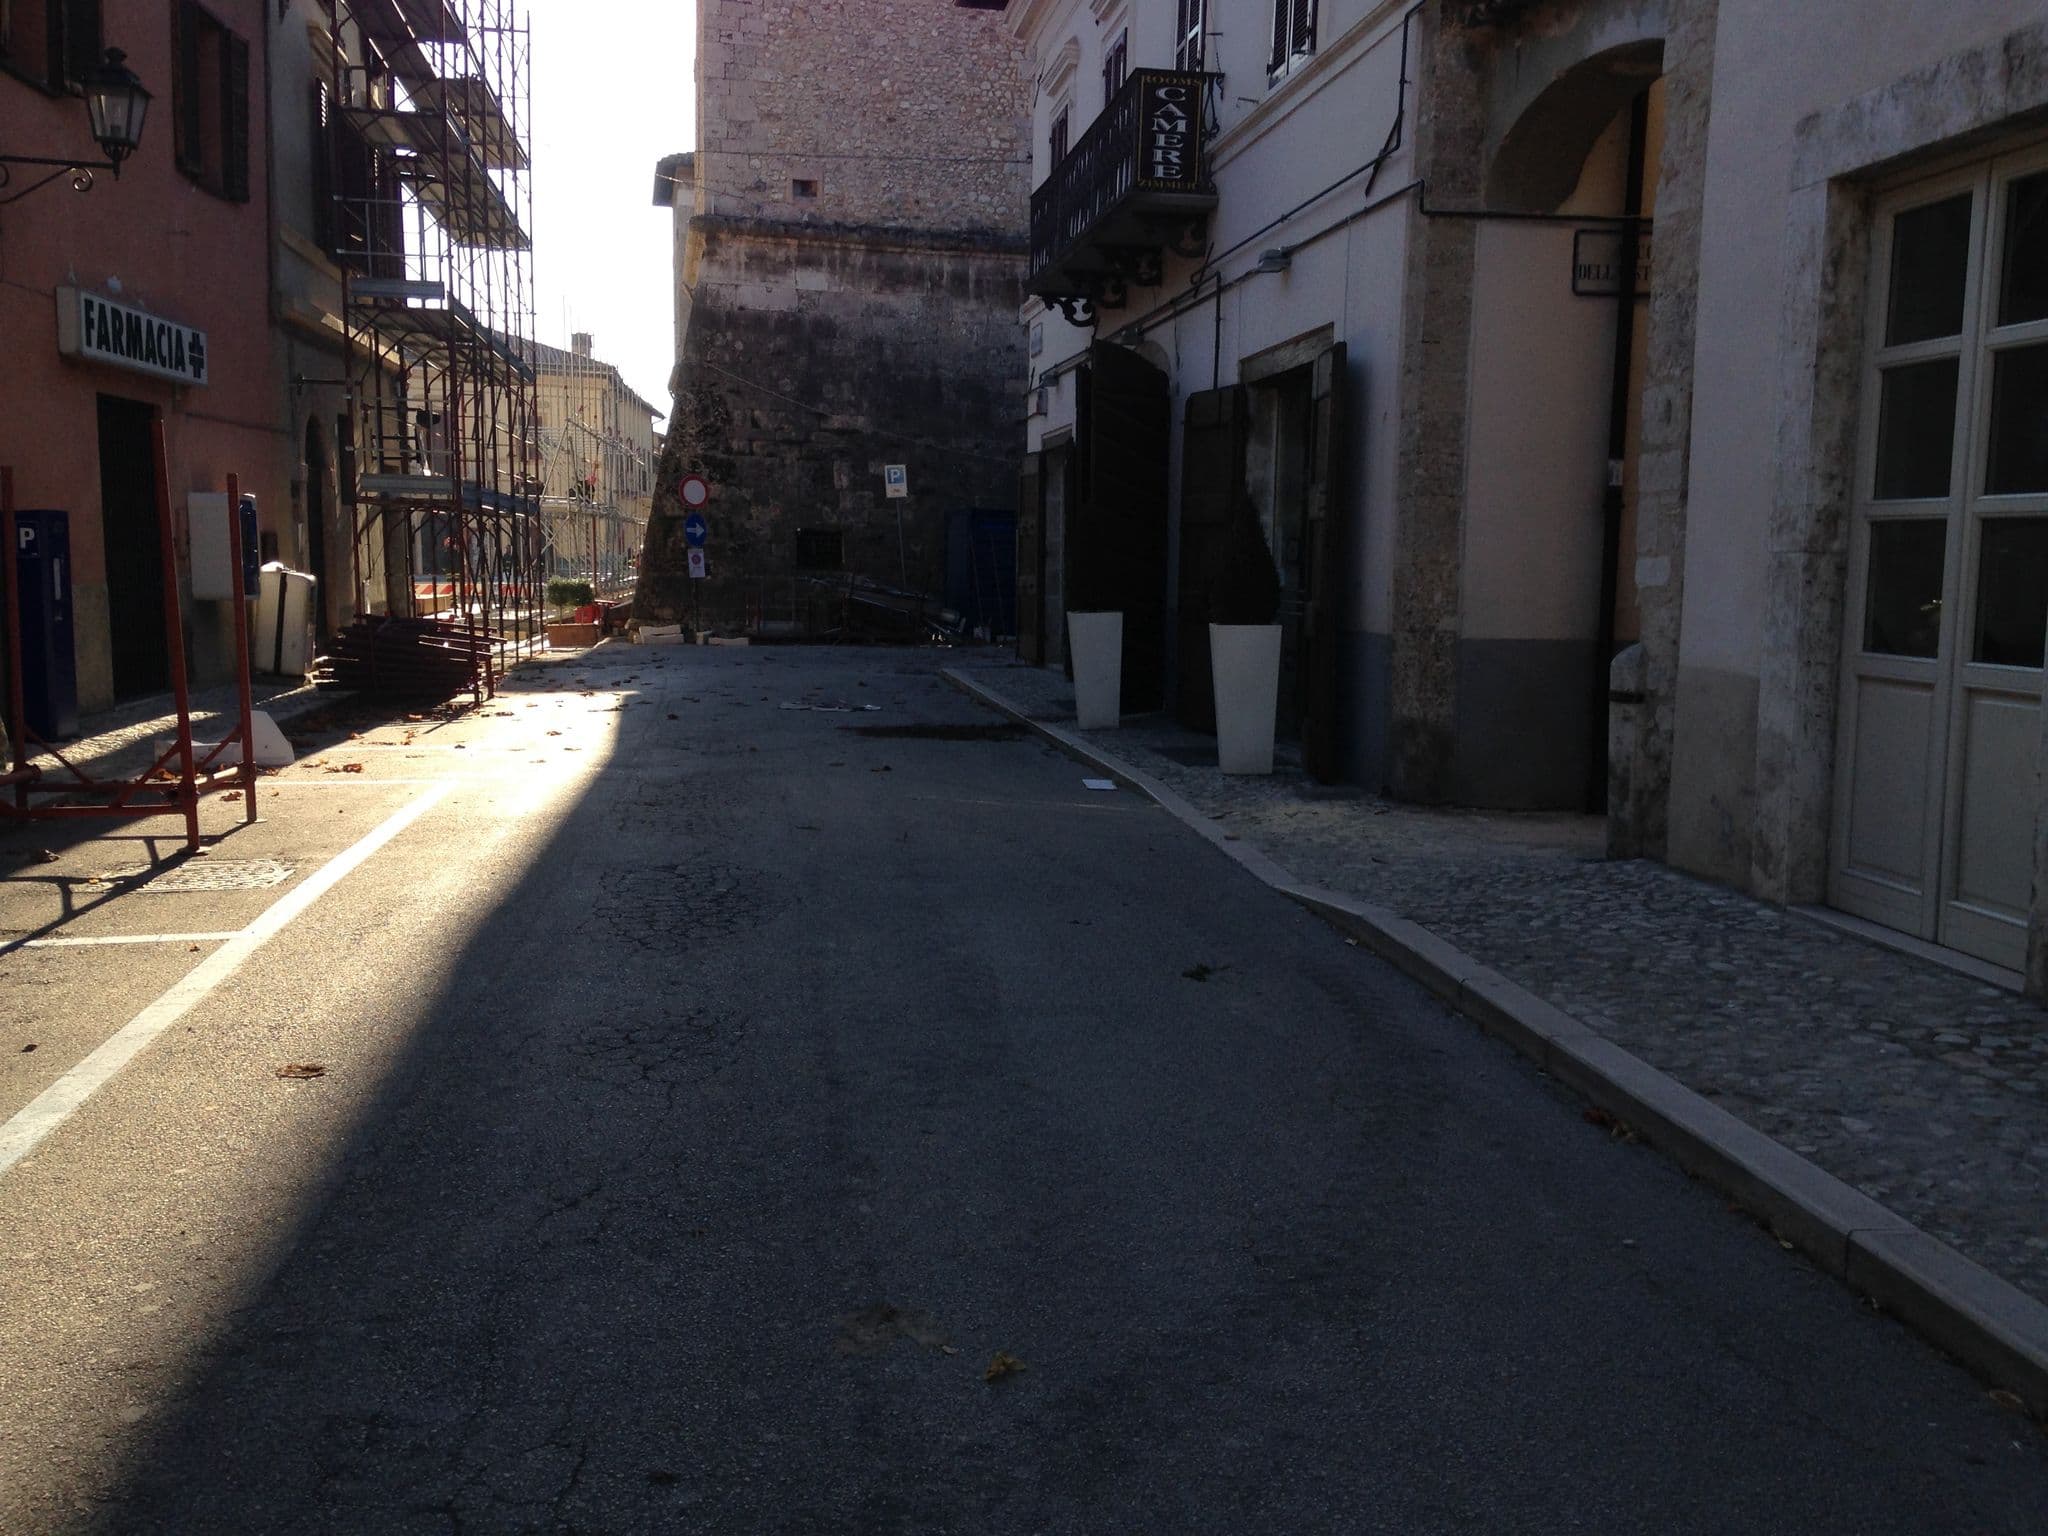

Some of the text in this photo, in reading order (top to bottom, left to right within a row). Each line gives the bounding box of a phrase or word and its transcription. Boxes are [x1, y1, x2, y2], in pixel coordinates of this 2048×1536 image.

[1145, 75, 1201, 86] ROOMS
[1151, 86, 1188, 179] CAMERE
[84, 298, 186, 373] FARMACIA
[19, 527, 36, 550] P
